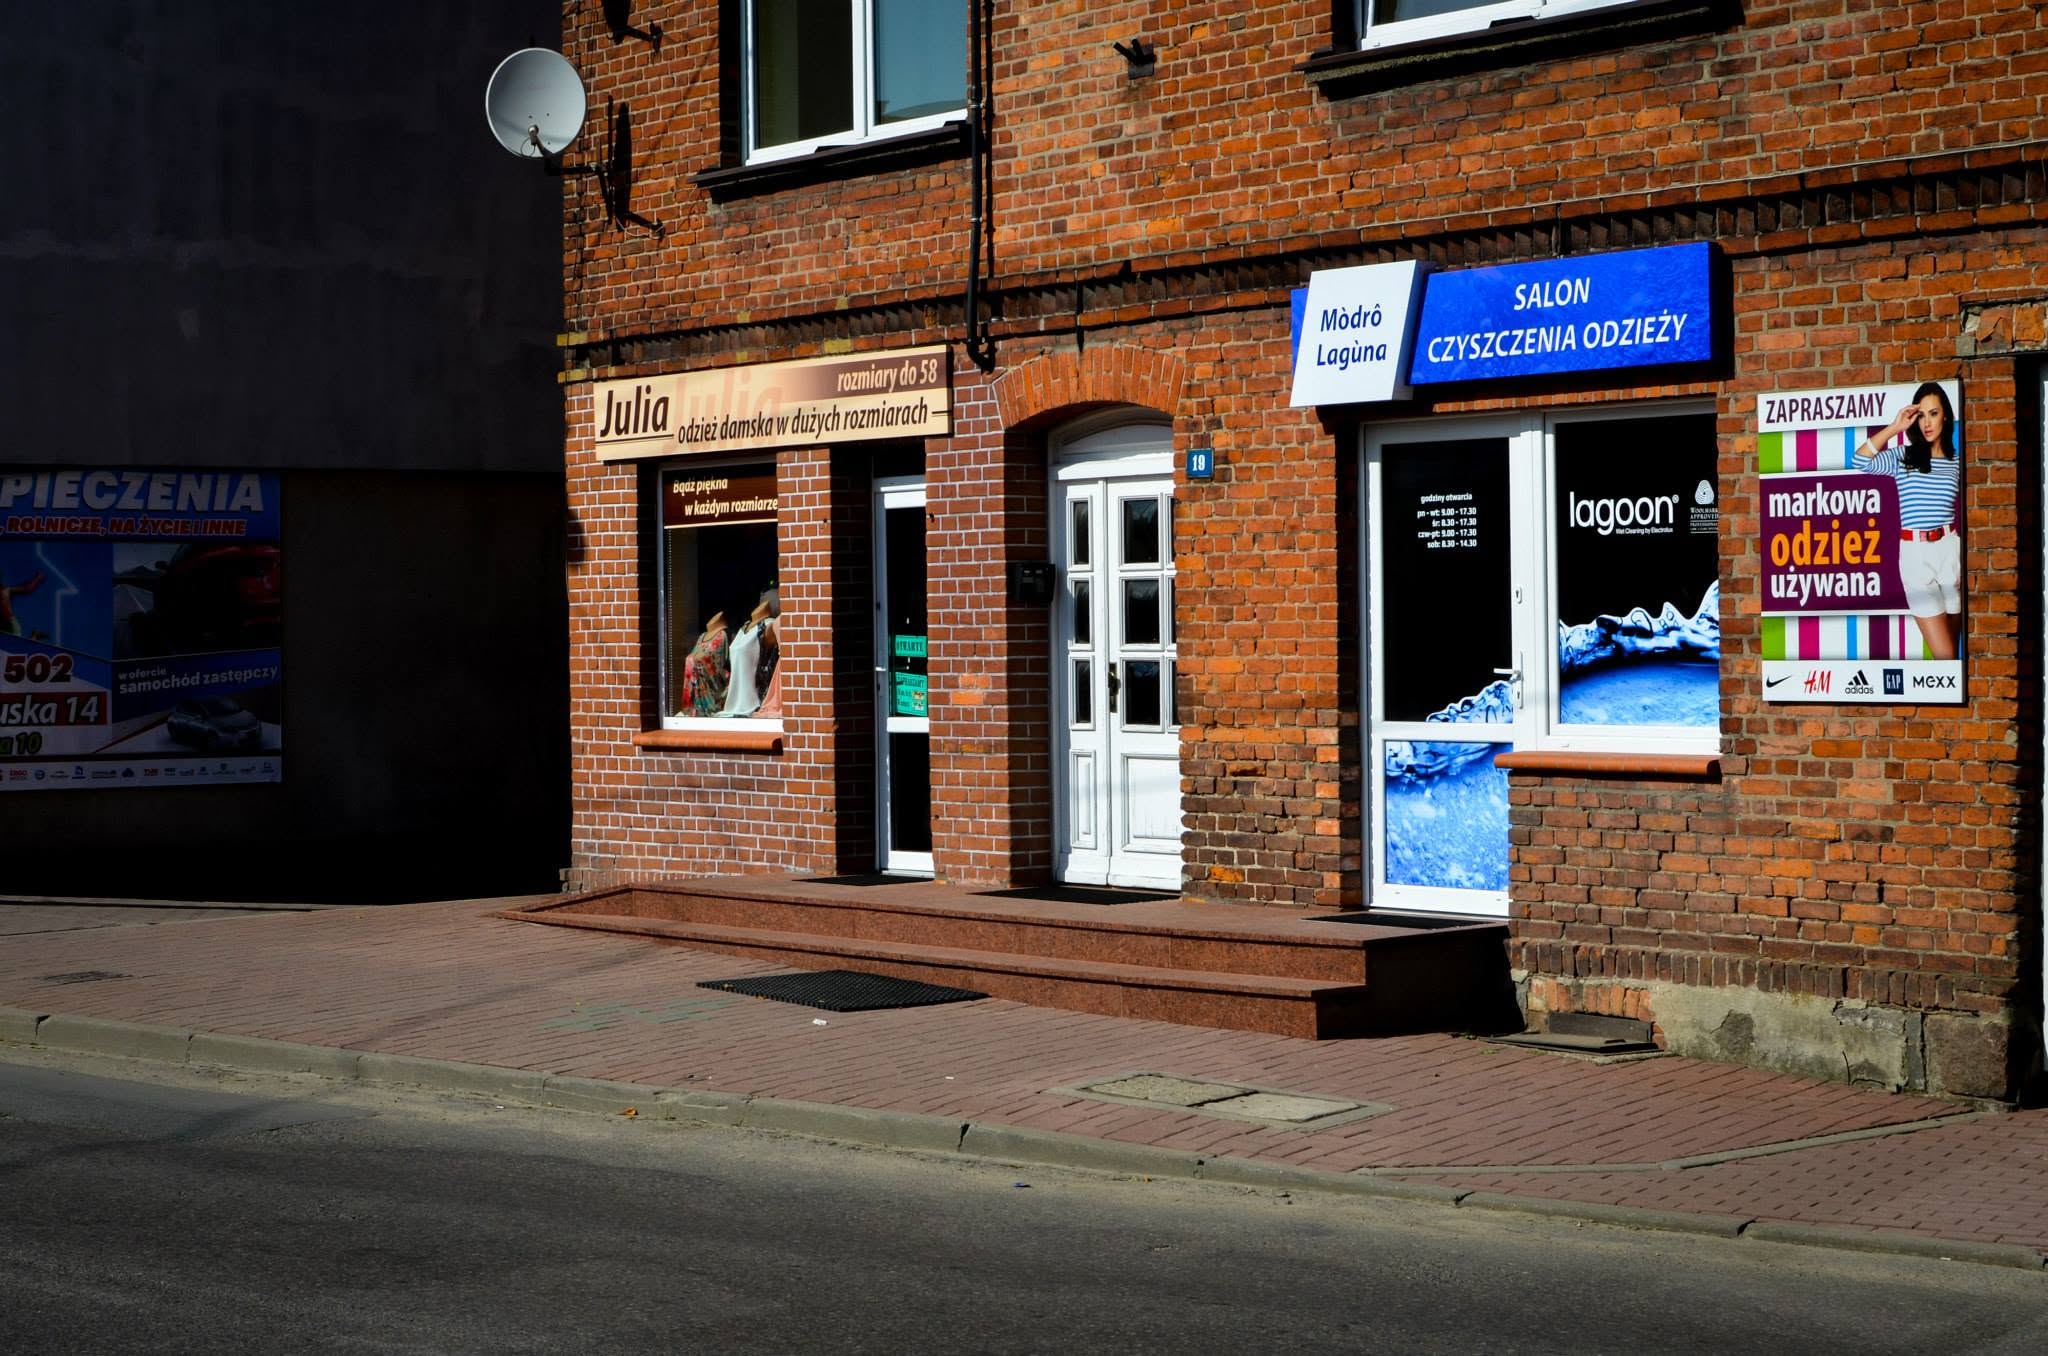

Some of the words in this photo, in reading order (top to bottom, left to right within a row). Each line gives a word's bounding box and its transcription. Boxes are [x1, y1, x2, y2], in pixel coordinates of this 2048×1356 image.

[1513, 277, 1590, 311] SALON
[1320, 303, 1382, 332] Mòdrô
[1427, 324, 1577, 363] CZYSZCZENIA
[1582, 309, 1688, 349] ODZIEŻY
[1316, 340, 1387, 371] Lagùna
[837, 363, 898, 393] rozmiary
[899, 360, 917, 386] do
[920, 358, 938, 384] 58
[600, 385, 670, 437] Julia
[678, 415, 718, 444] odzież
[720, 410, 774, 441] damska
[776, 415, 789, 435] w
[791, 404, 840, 440] dużych
[843, 396, 928, 430] rozmiarach
[1765, 392, 1886, 424] ZAPRASZAMY
[1192, 454, 1206, 472] 19
[0, 471, 264, 511] PIECZENIA
[696, 476, 728, 495] piękna
[1420, 494, 1445, 504] godziny
[1445, 492, 1473, 501] otwarcia
[684, 504, 692, 516] w
[694, 499, 729, 518] każdym
[731, 496, 778, 513] rozmiarze
[1441, 508, 1455, 516] 9.00
[1459, 507, 1477, 515] 17.30
[1769, 482, 1881, 518] markowa
[109, 517, 135, 535] NA
[1441, 518, 1455, 527] 8.30
[1459, 518, 1477, 526] 17.30
[1441, 529, 1455, 537] 9.00
[1459, 528, 1477, 537] 17.30
[1441, 540, 1455, 548] 8.30
[1459, 539, 1477, 547] 14.30
[1770, 518, 1881, 567] odzież
[1770, 565, 1881, 607] używana
[4, 654, 73, 683] 502
[119, 672, 201, 695] samochód
[202, 665, 279, 685] zastępczy
[1803, 670, 1832, 694] H&M
[1886, 674, 1901, 689] GAP
[1844, 685, 1874, 695] adidas
[66, 696, 99, 724] 14
[16, 732, 42, 754] 10
